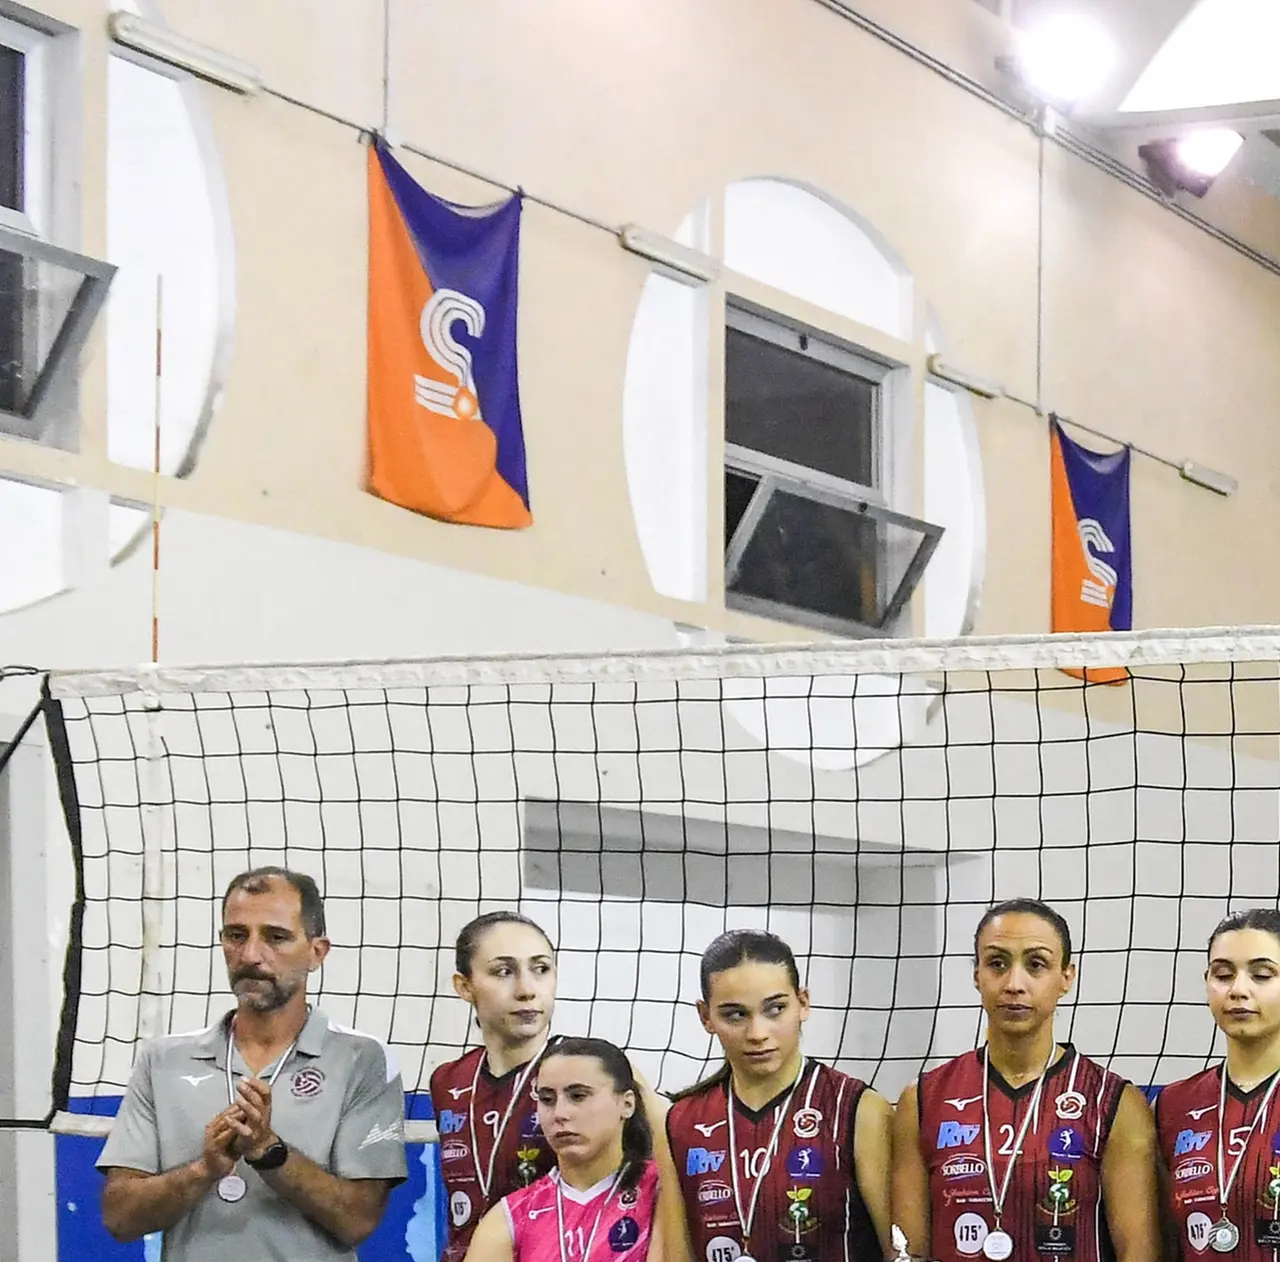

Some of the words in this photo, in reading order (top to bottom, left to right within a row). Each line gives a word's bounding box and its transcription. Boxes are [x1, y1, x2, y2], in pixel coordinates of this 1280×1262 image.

[483, 1110, 501, 1139] 9
[998, 1124, 1023, 1155] 2
[1227, 1126, 1252, 1156] 5
[740, 1148, 770, 1179] 10
